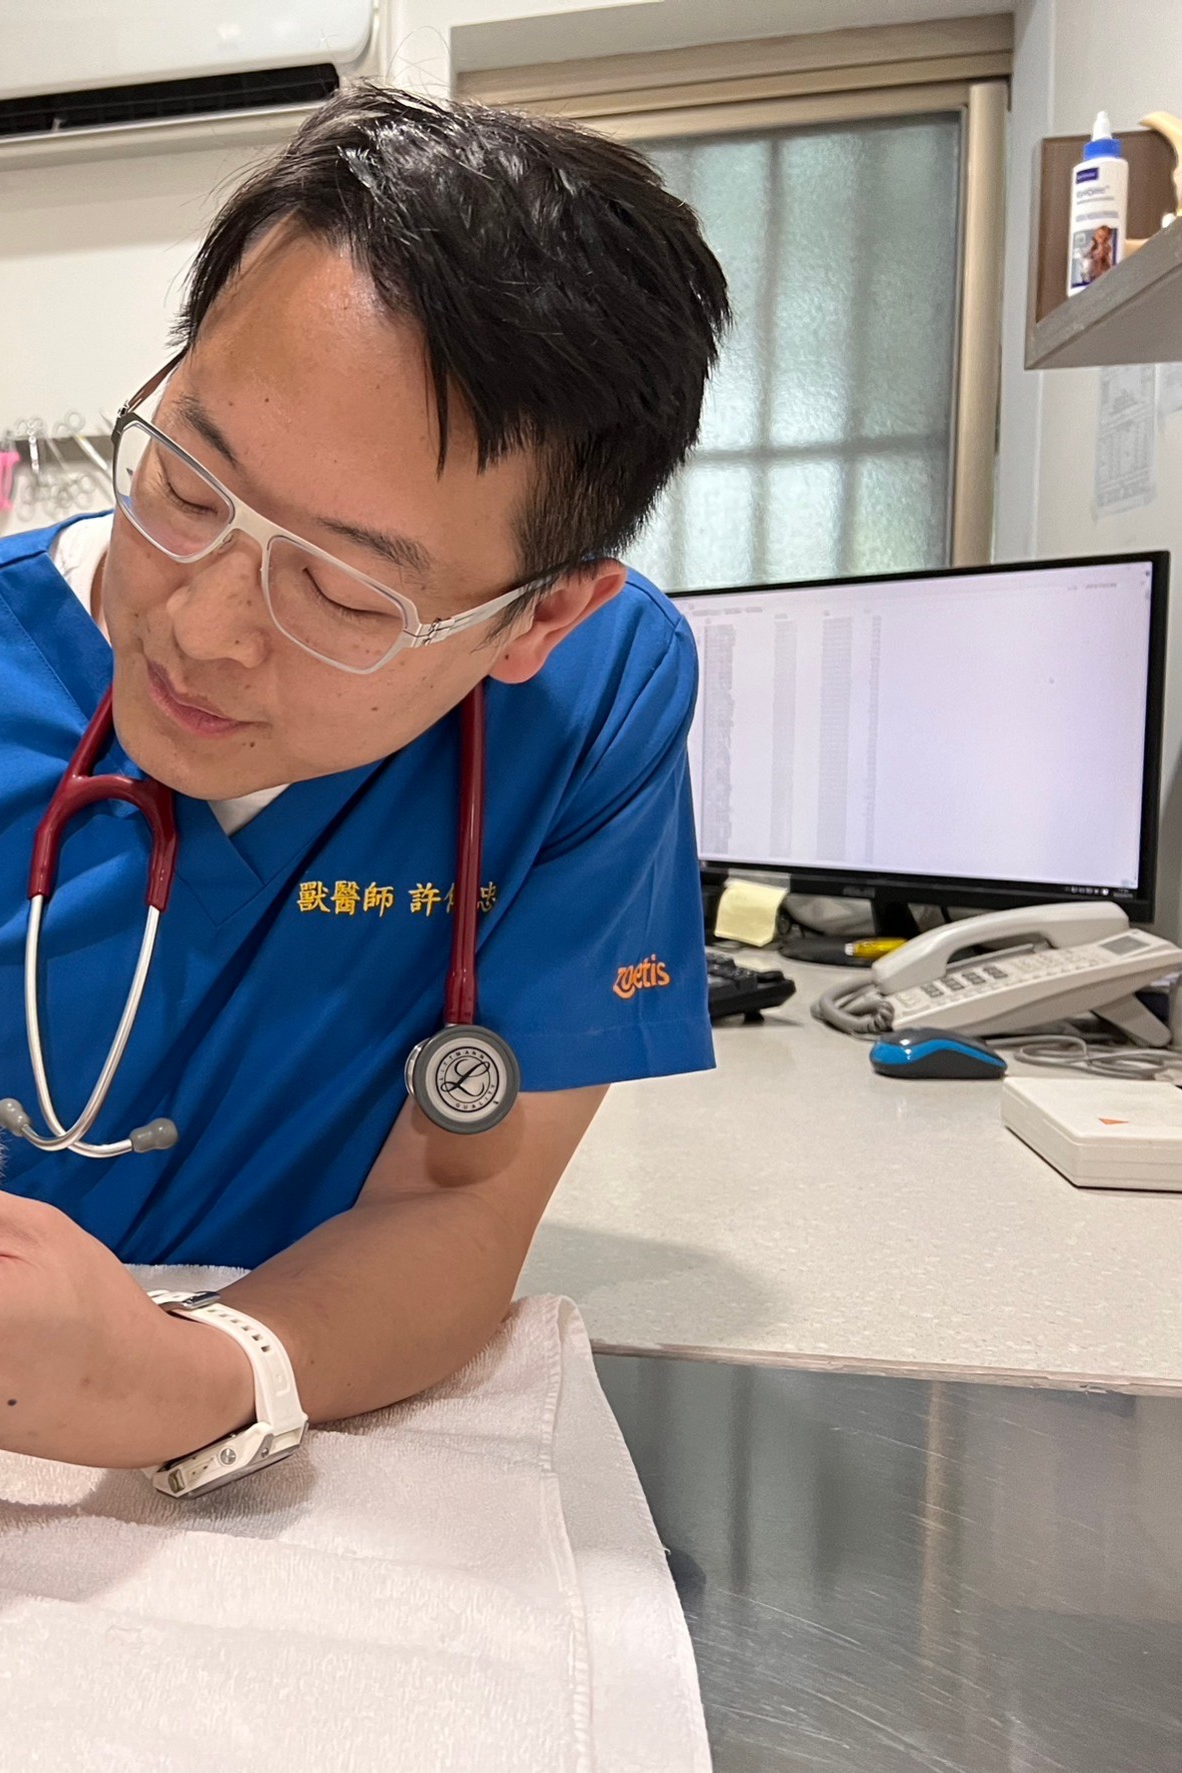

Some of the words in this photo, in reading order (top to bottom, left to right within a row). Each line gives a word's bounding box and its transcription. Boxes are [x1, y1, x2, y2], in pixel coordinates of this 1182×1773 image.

[297, 880, 395, 918] 獸醫師
[408, 881, 498, 917] 許忠
[613, 953, 671, 999] zoetis
[439, 1049, 485, 1082] LITTMANN
[455, 1084, 496, 1110] QUALITY
